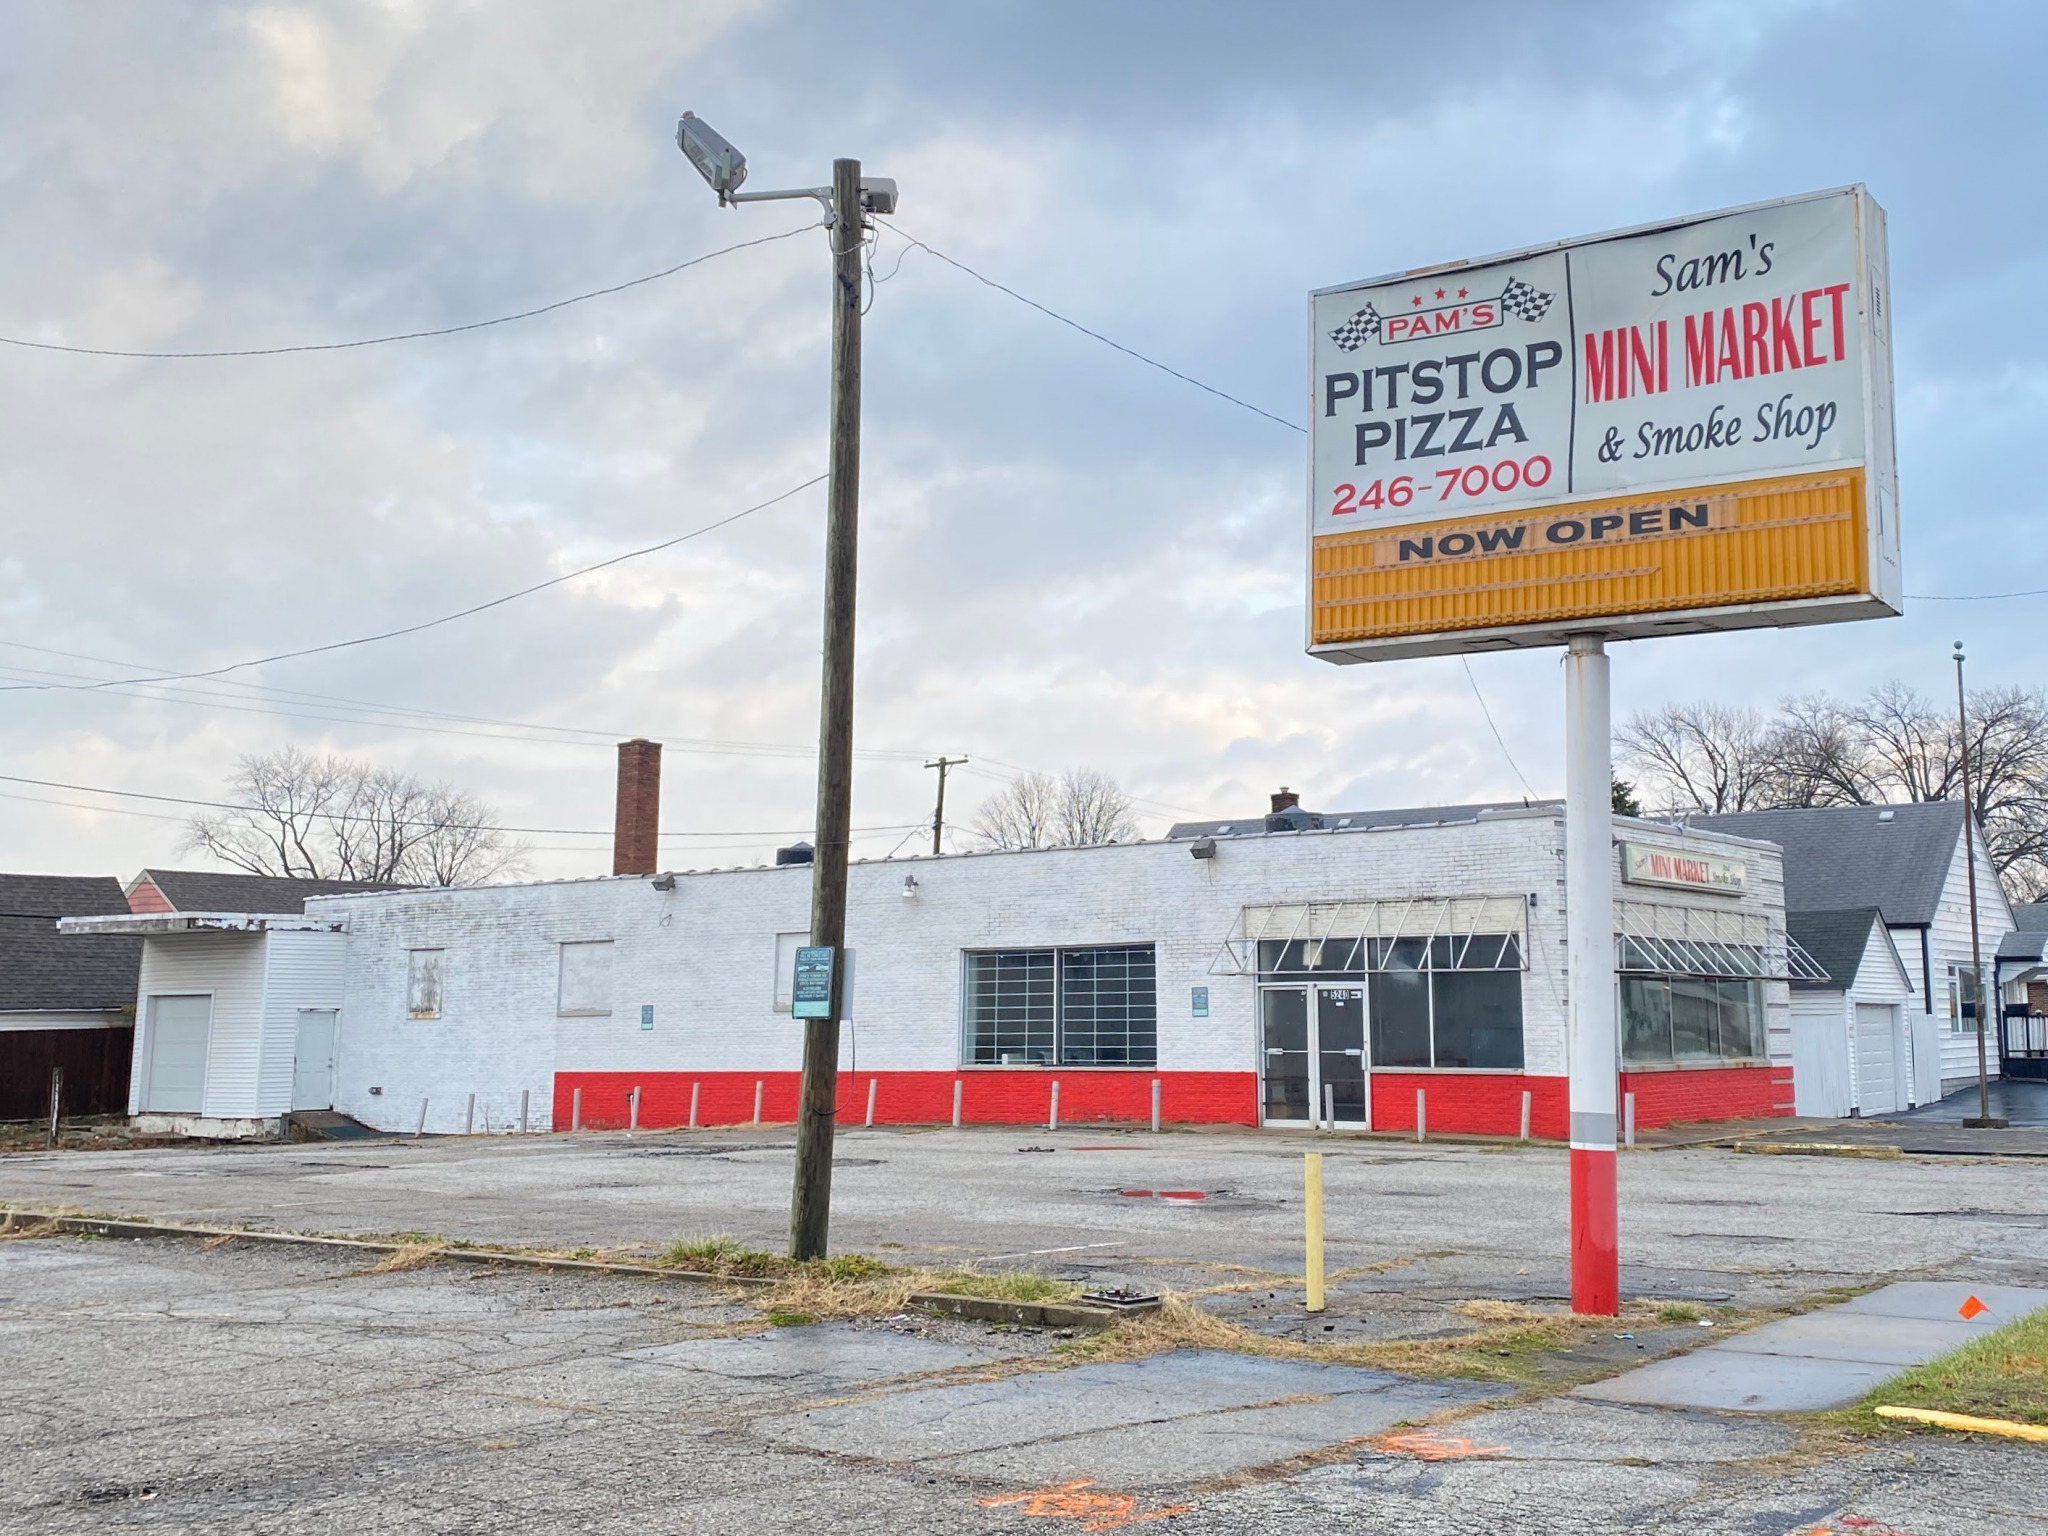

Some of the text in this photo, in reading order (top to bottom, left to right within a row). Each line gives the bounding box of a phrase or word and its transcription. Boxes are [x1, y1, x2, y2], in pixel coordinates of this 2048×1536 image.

[1651, 233, 1774, 296] Sam's
[1388, 304, 1495, 340] PAM'S
[1585, 282, 1850, 404] MINI MARKET
[1325, 340, 1562, 417] PITSTOP
[1355, 402, 1529, 466] PIZZA
[1598, 393, 1837, 463] & Smoke Shop
[1332, 455, 1552, 516] 246-7000
[1400, 504, 1708, 560] NOW OPEN
[1650, 853, 1710, 884] MINI MARKET
[1331, 989, 1349, 999] 5240
